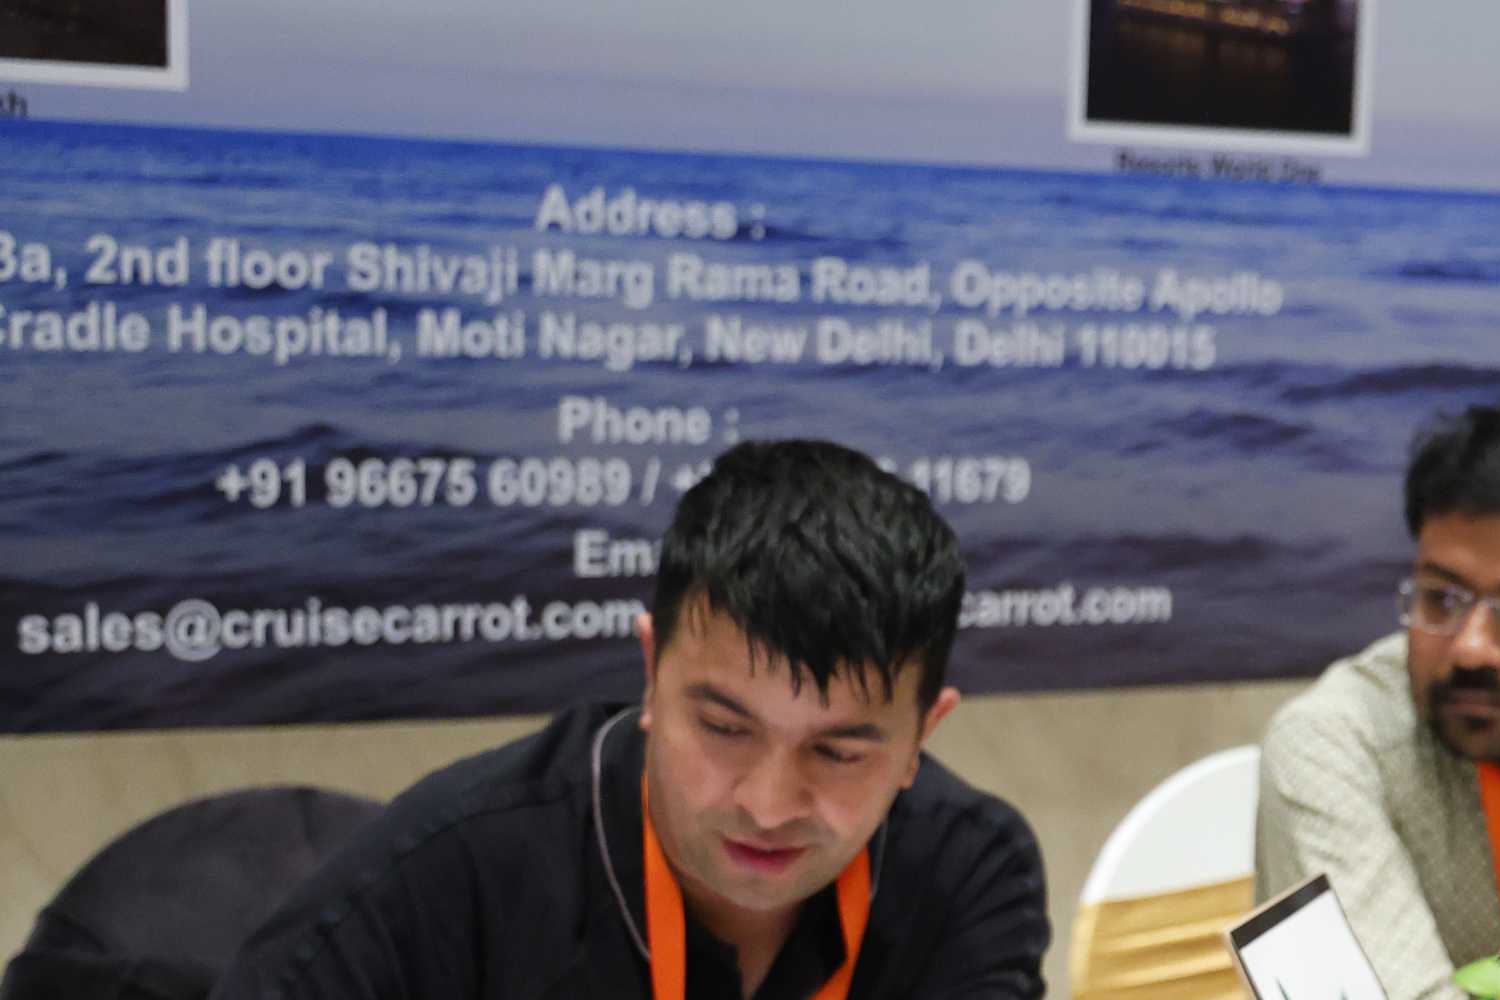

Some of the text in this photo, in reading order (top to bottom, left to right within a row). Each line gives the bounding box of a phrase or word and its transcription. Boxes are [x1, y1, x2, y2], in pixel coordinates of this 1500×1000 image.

[536, 184, 738, 240] Address
[84, 234, 189, 287] 2nd
[206, 237, 331, 290] floor
[345, 243, 518, 305] Shivaji
[532, 251, 655, 310] Marg
[667, 256, 799, 301] Rama
[812, 257, 941, 314] Road,
[951, 260, 1141, 315] Opposite
[1151, 268, 1283, 315] Apollo
[0, 300, 1216, 372] radle Hospital, Moti Nagar, New Delhi, Delhi 110015
[558, 396, 711, 445] Phone
[215, 459, 306, 506] +91
[326, 459, 476, 507] 96675
[489, 458, 632, 507] 60989
[17, 596, 647, 662] sales@cruisecarrot.com
[958, 581, 1172, 629] carrot.com
